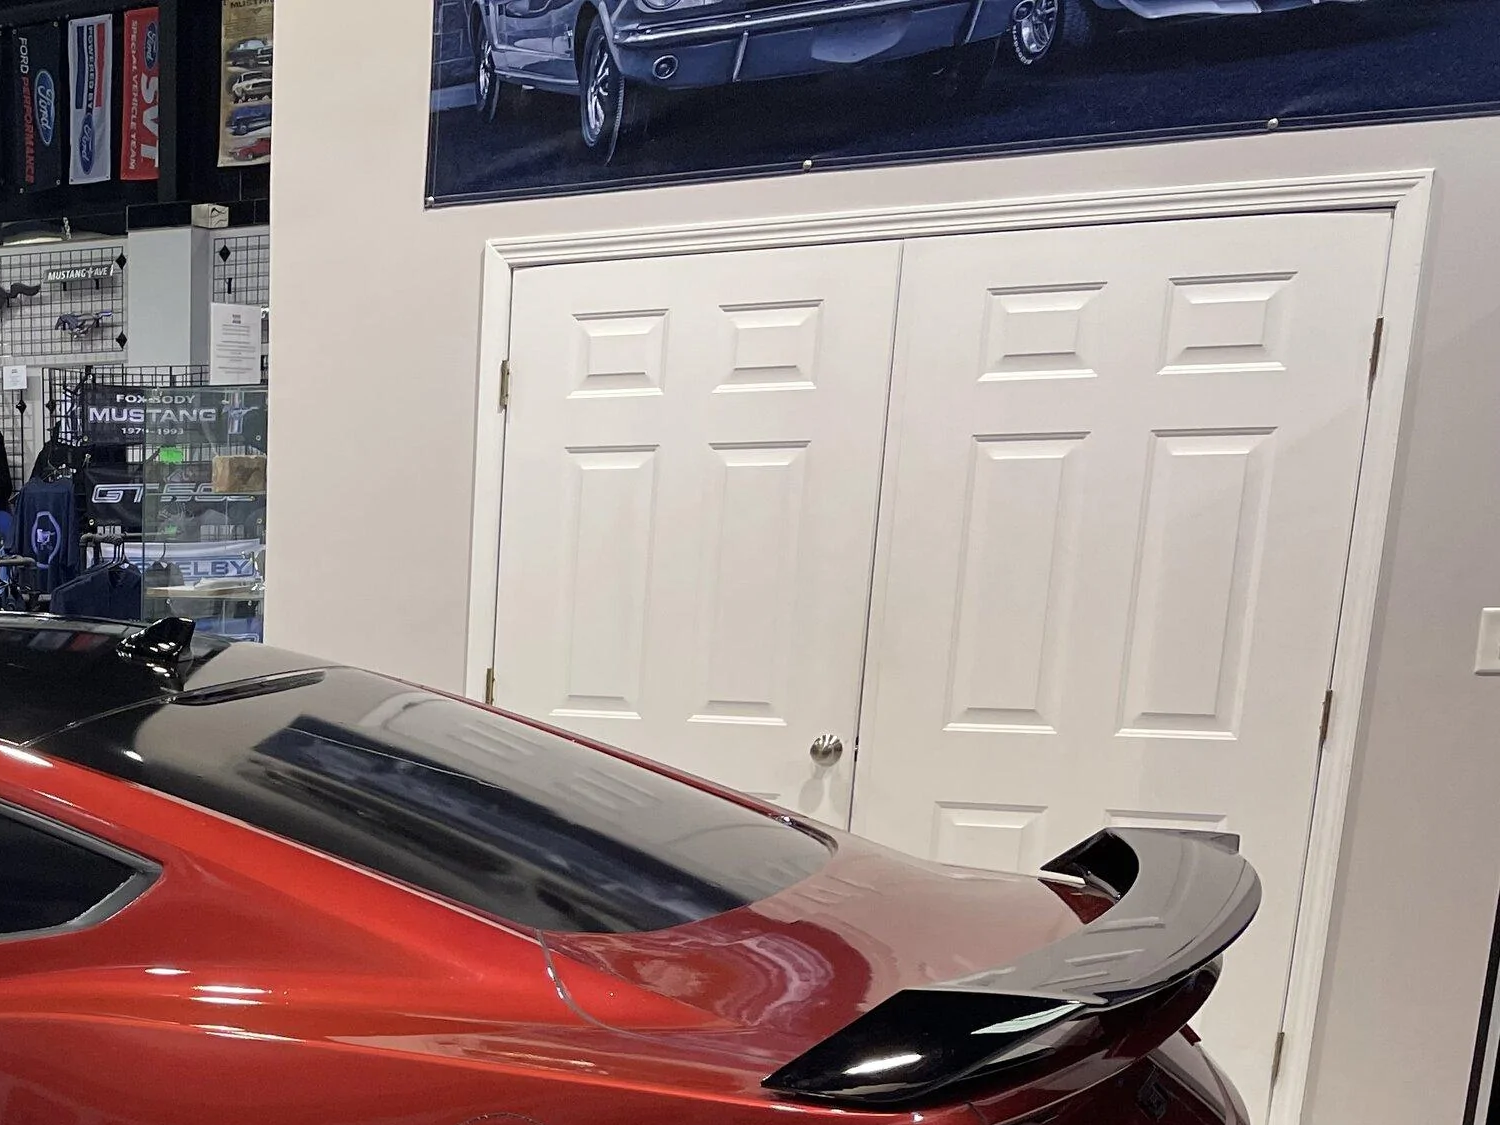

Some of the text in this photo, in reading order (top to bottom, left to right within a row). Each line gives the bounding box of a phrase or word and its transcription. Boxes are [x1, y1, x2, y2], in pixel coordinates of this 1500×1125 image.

[87, 26, 95, 110] POWERED BY
[145, 30, 158, 61] Ford
[18, 37, 34, 184] FORD PERFORMANCE
[37, 85, 54, 131] Ford
[129, 19, 138, 170] SPECIAL VEHICLE TEAM
[81, 124, 93, 161] Ford
[140, 72, 159, 168] SVT
[47, 267, 108, 281] MUSTANG AVE
[88, 407, 217, 423] MUSTANG
